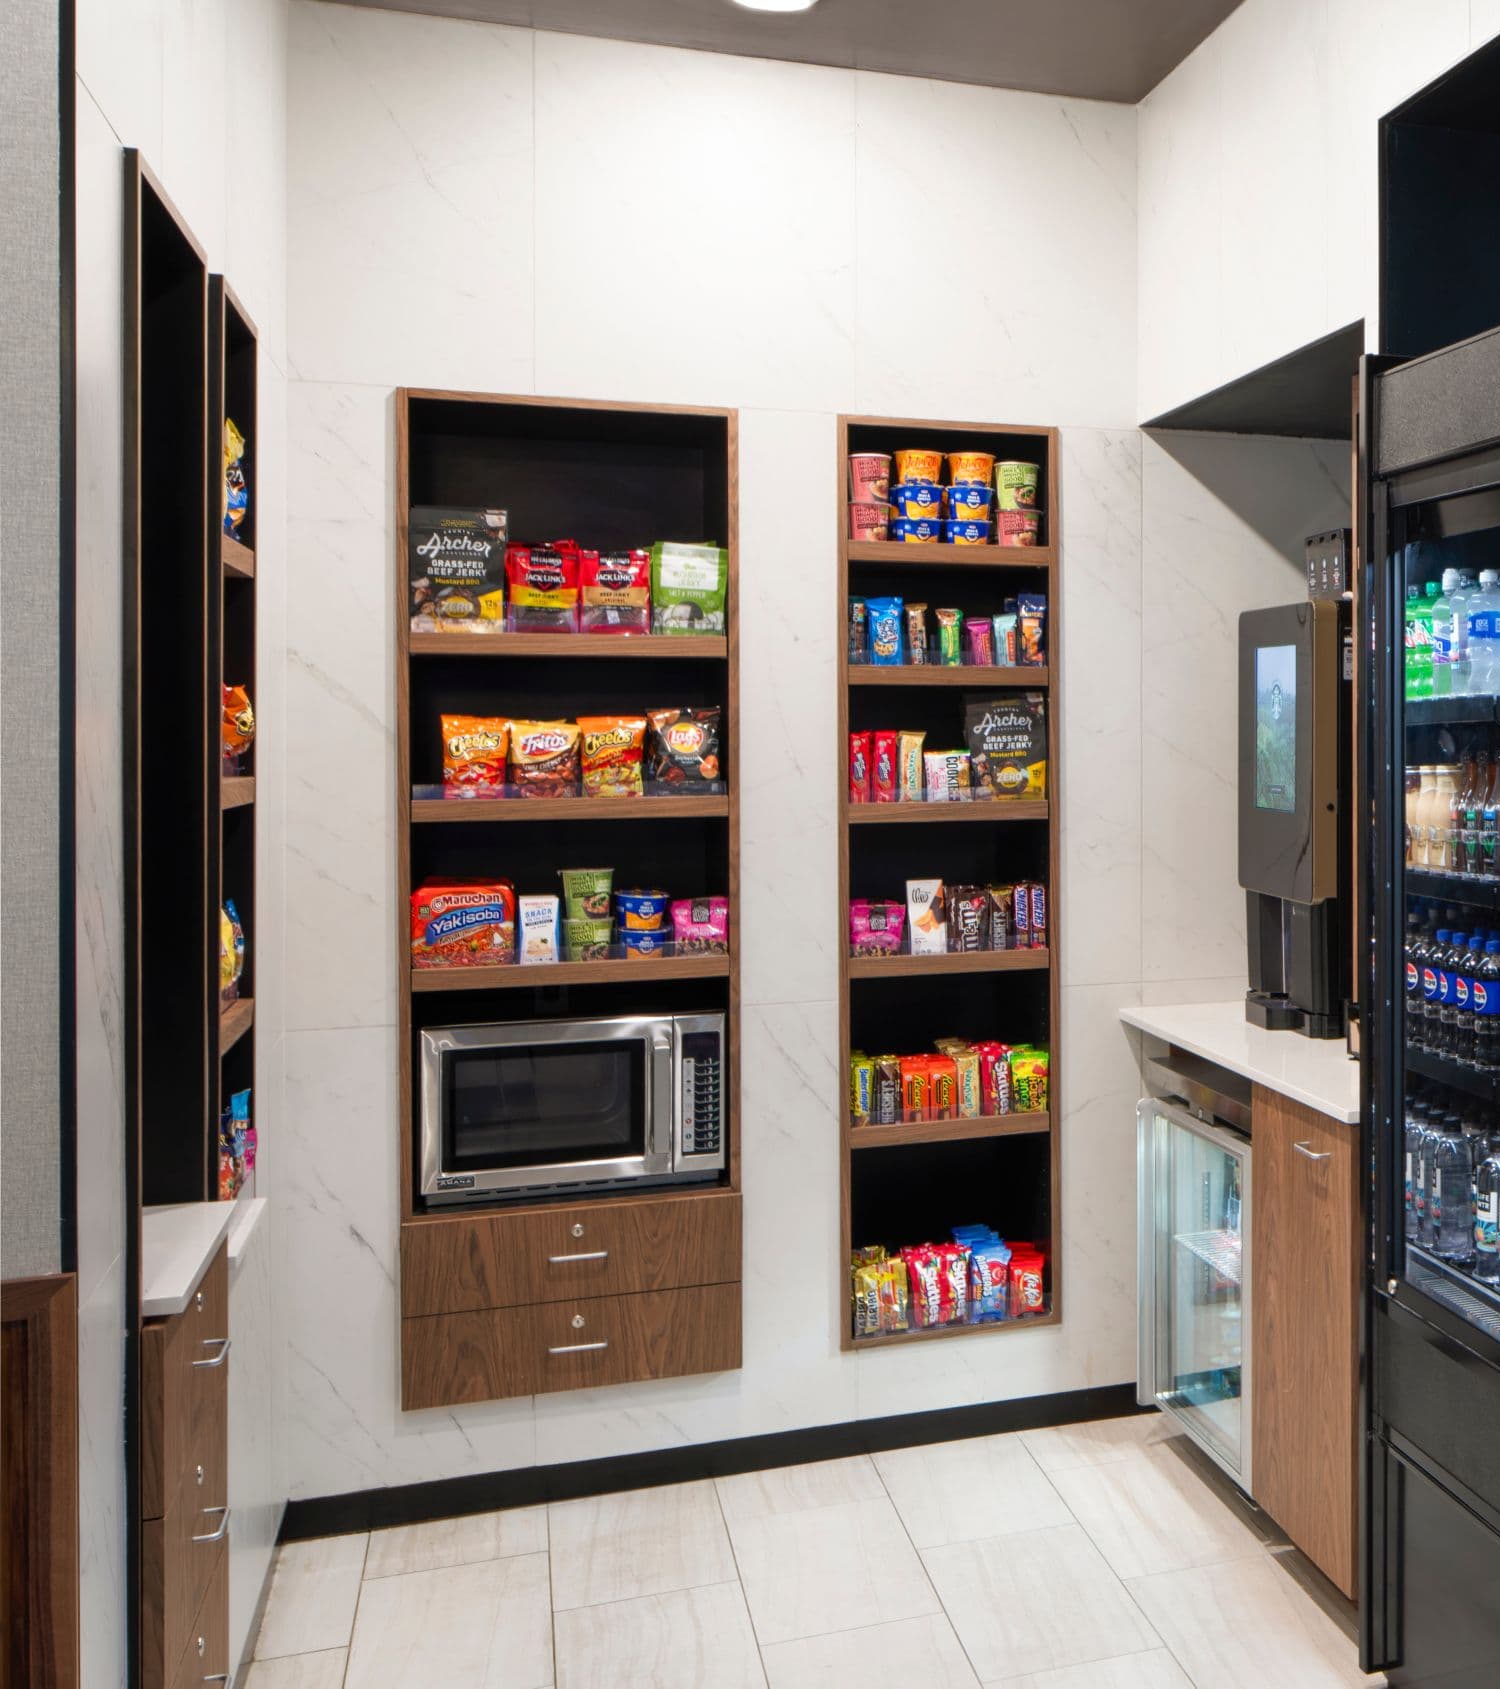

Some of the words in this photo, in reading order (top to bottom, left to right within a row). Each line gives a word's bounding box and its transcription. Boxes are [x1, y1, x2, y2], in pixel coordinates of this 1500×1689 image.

[416, 532, 491, 558] Archer
[427, 567, 453, 576] BEEF
[456, 568, 487, 577] JERKY
[973, 713, 1032, 736] Archer
[449, 732, 500, 758] Cheetos
[521, 732, 567, 755] Fritos
[584, 729, 632, 756] Cheetos
[1007, 742, 1032, 750] JERKY
[442, 893, 500, 905] Maruchan
[1015, 888, 1028, 929] SNICKERS
[1032, 888, 1045, 927] SNICKERS
[432, 910, 500, 934] Yakisoba
[525, 908, 552, 918] SNACK
[994, 1061, 1009, 1115] Skittles
[952, 1259, 967, 1317] Skittles
[976, 1255, 993, 1297] AIRHEADS
[927, 1266, 940, 1323] Skittles
[857, 1297, 866, 1329] ARIBO
